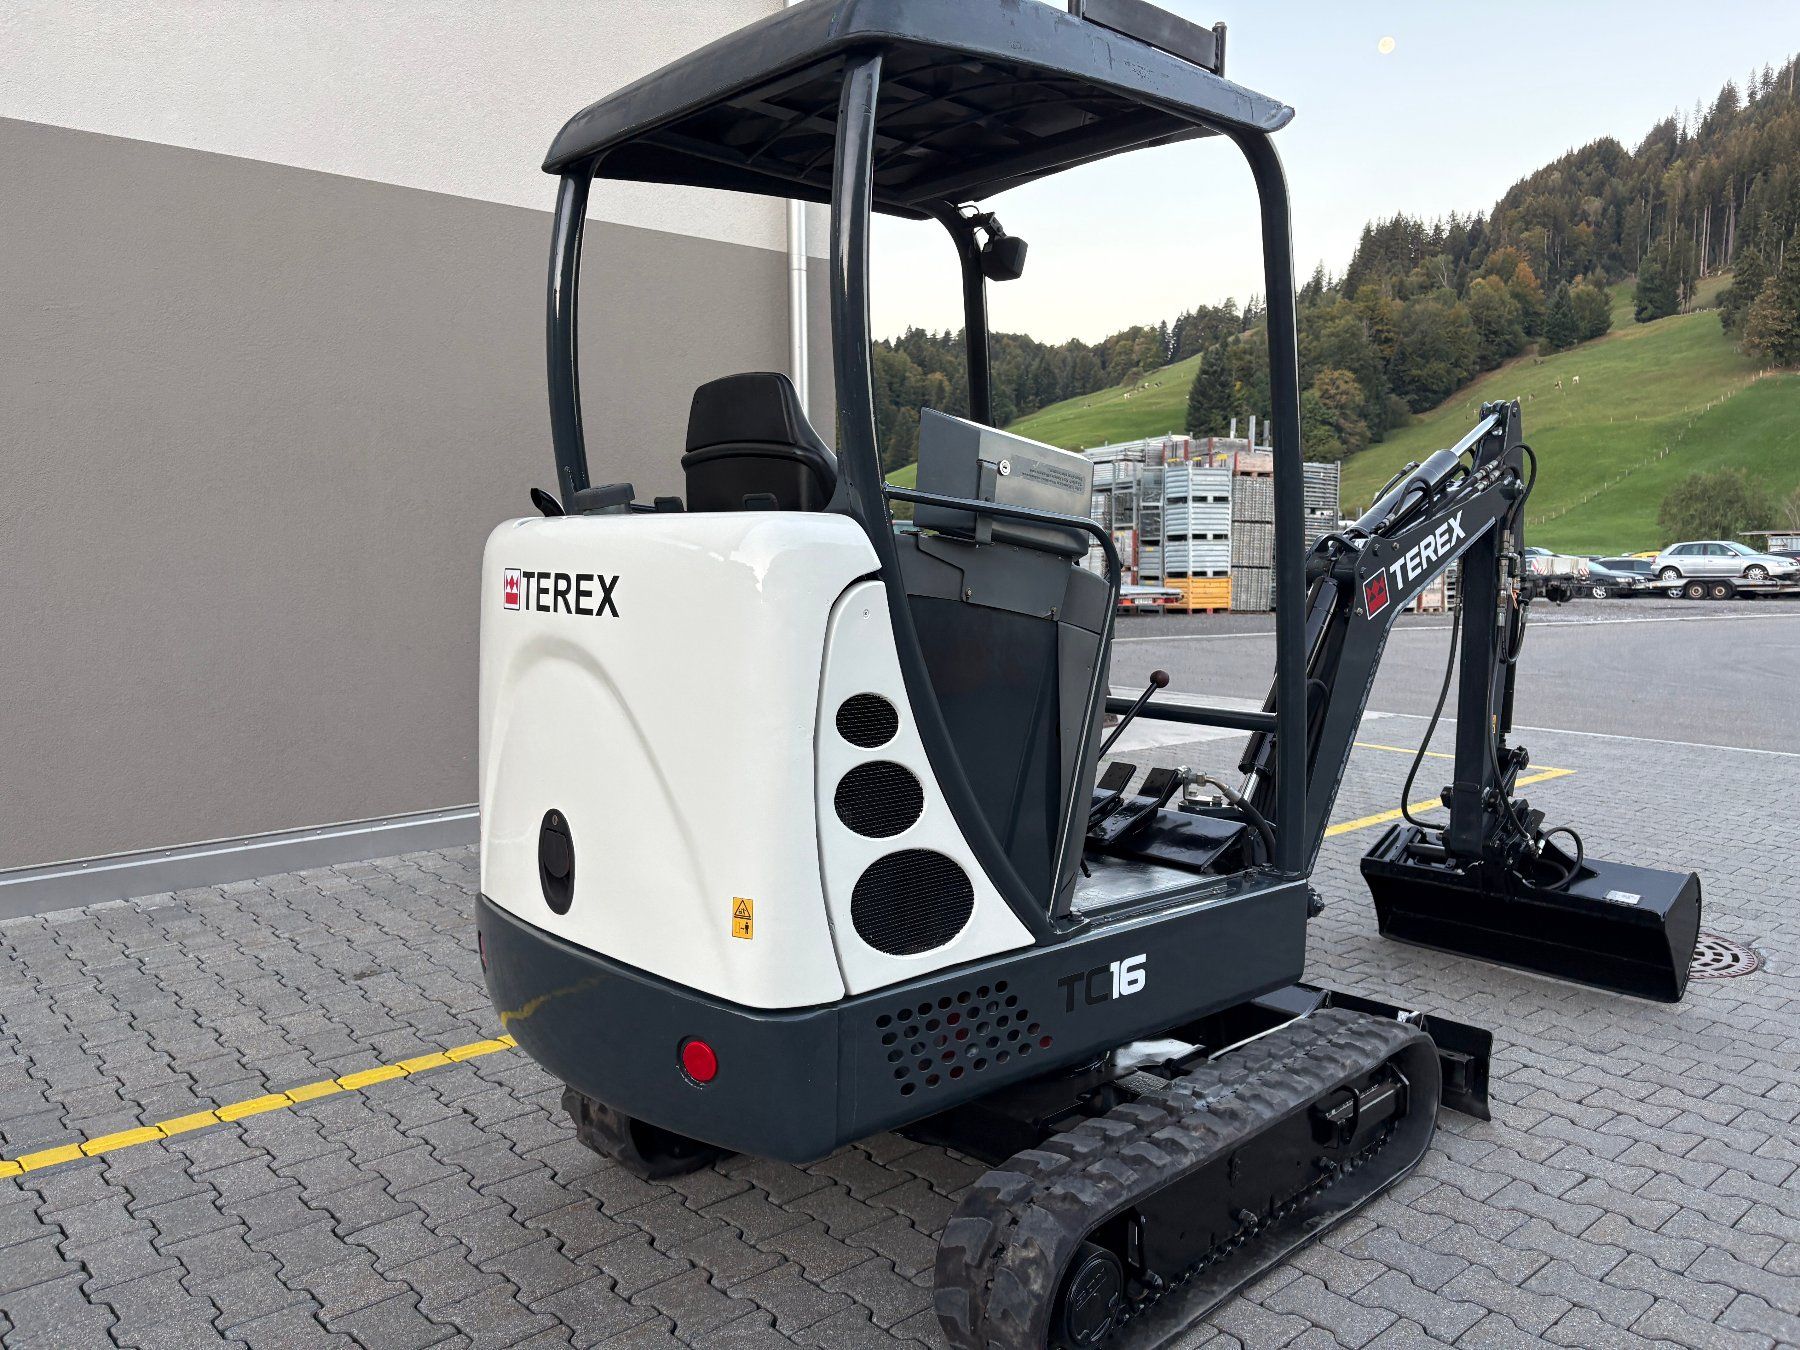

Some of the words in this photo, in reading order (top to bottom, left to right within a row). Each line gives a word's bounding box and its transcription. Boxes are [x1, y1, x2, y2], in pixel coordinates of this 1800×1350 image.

[1389, 509, 1466, 591] TEREX
[522, 570, 620, 618] TEREX
[1057, 953, 1147, 1013] TC16
